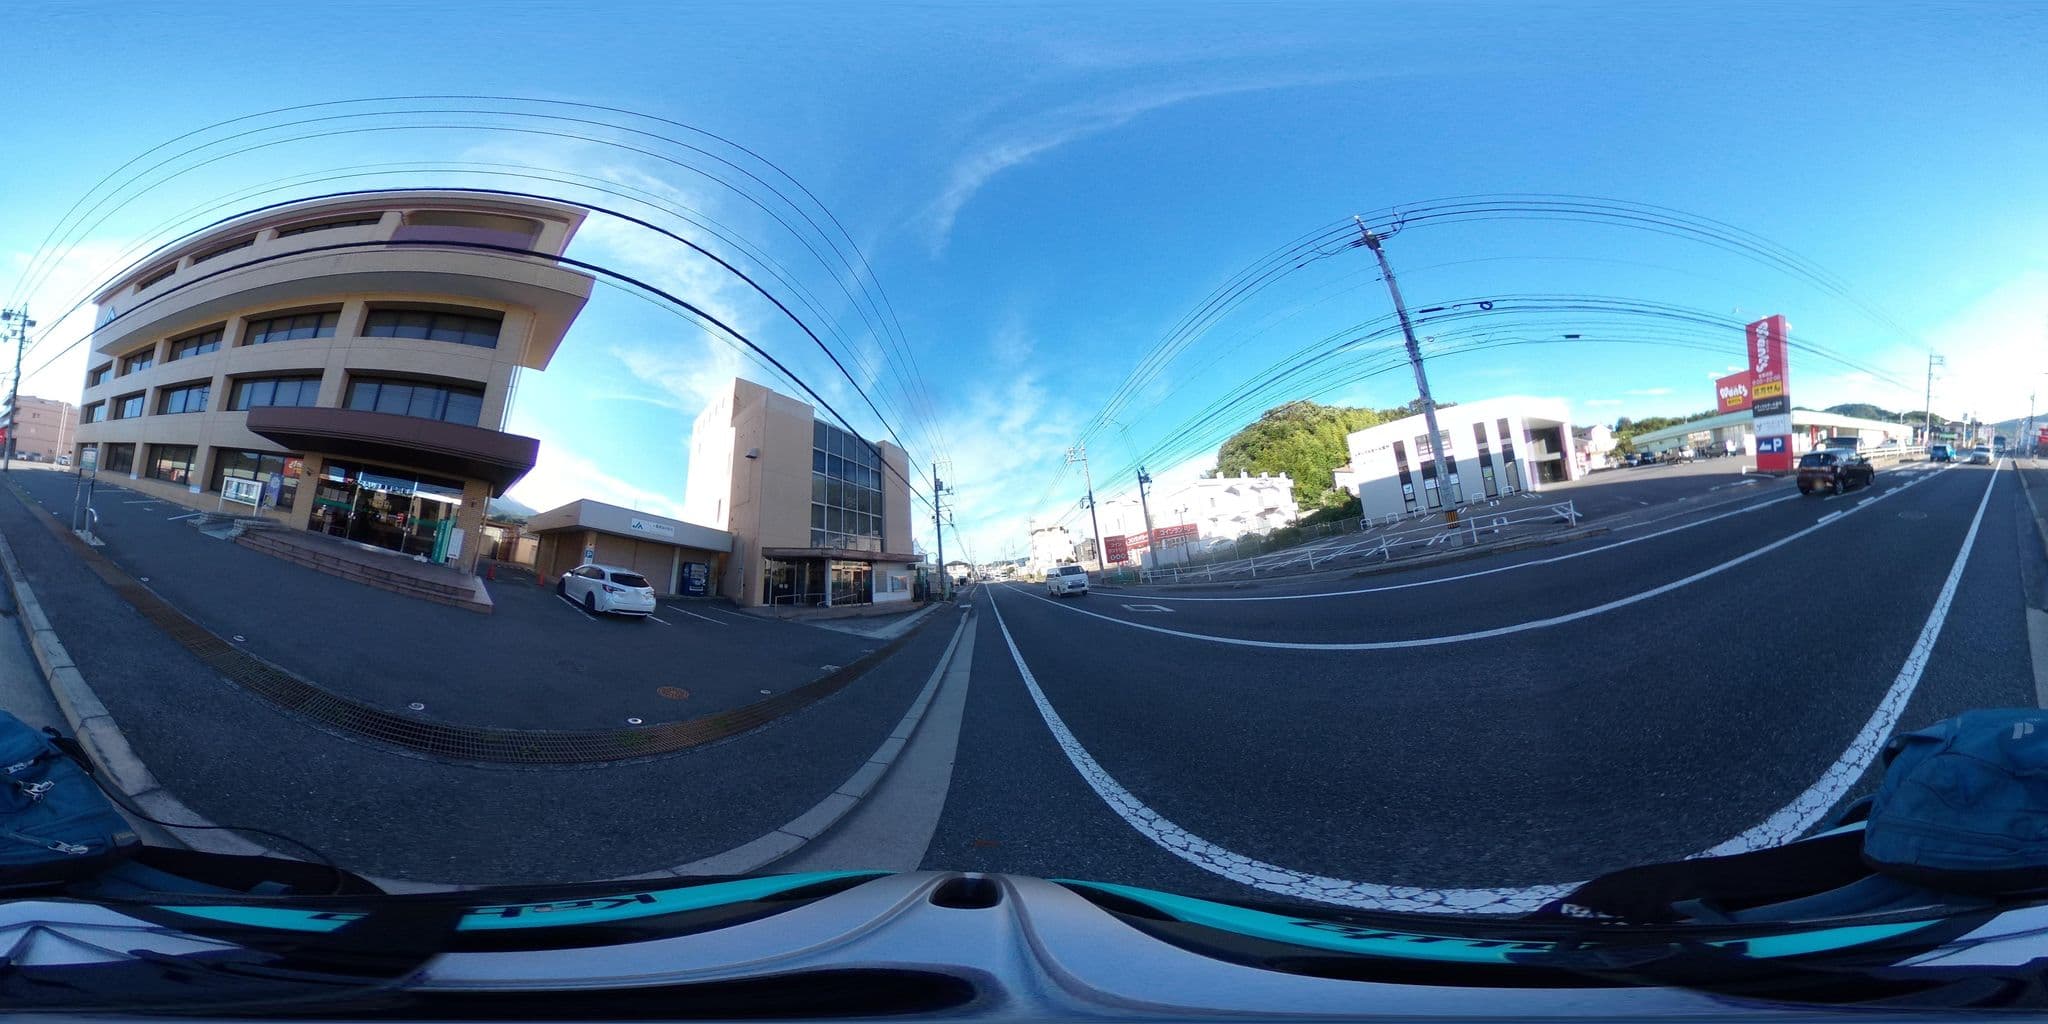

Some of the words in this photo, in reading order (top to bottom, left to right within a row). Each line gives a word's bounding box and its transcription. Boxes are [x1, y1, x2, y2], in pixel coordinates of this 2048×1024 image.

[1756, 322, 1769, 372] Wants
[1720, 384, 1748, 399] Wants
[1773, 438, 1783, 452] P
